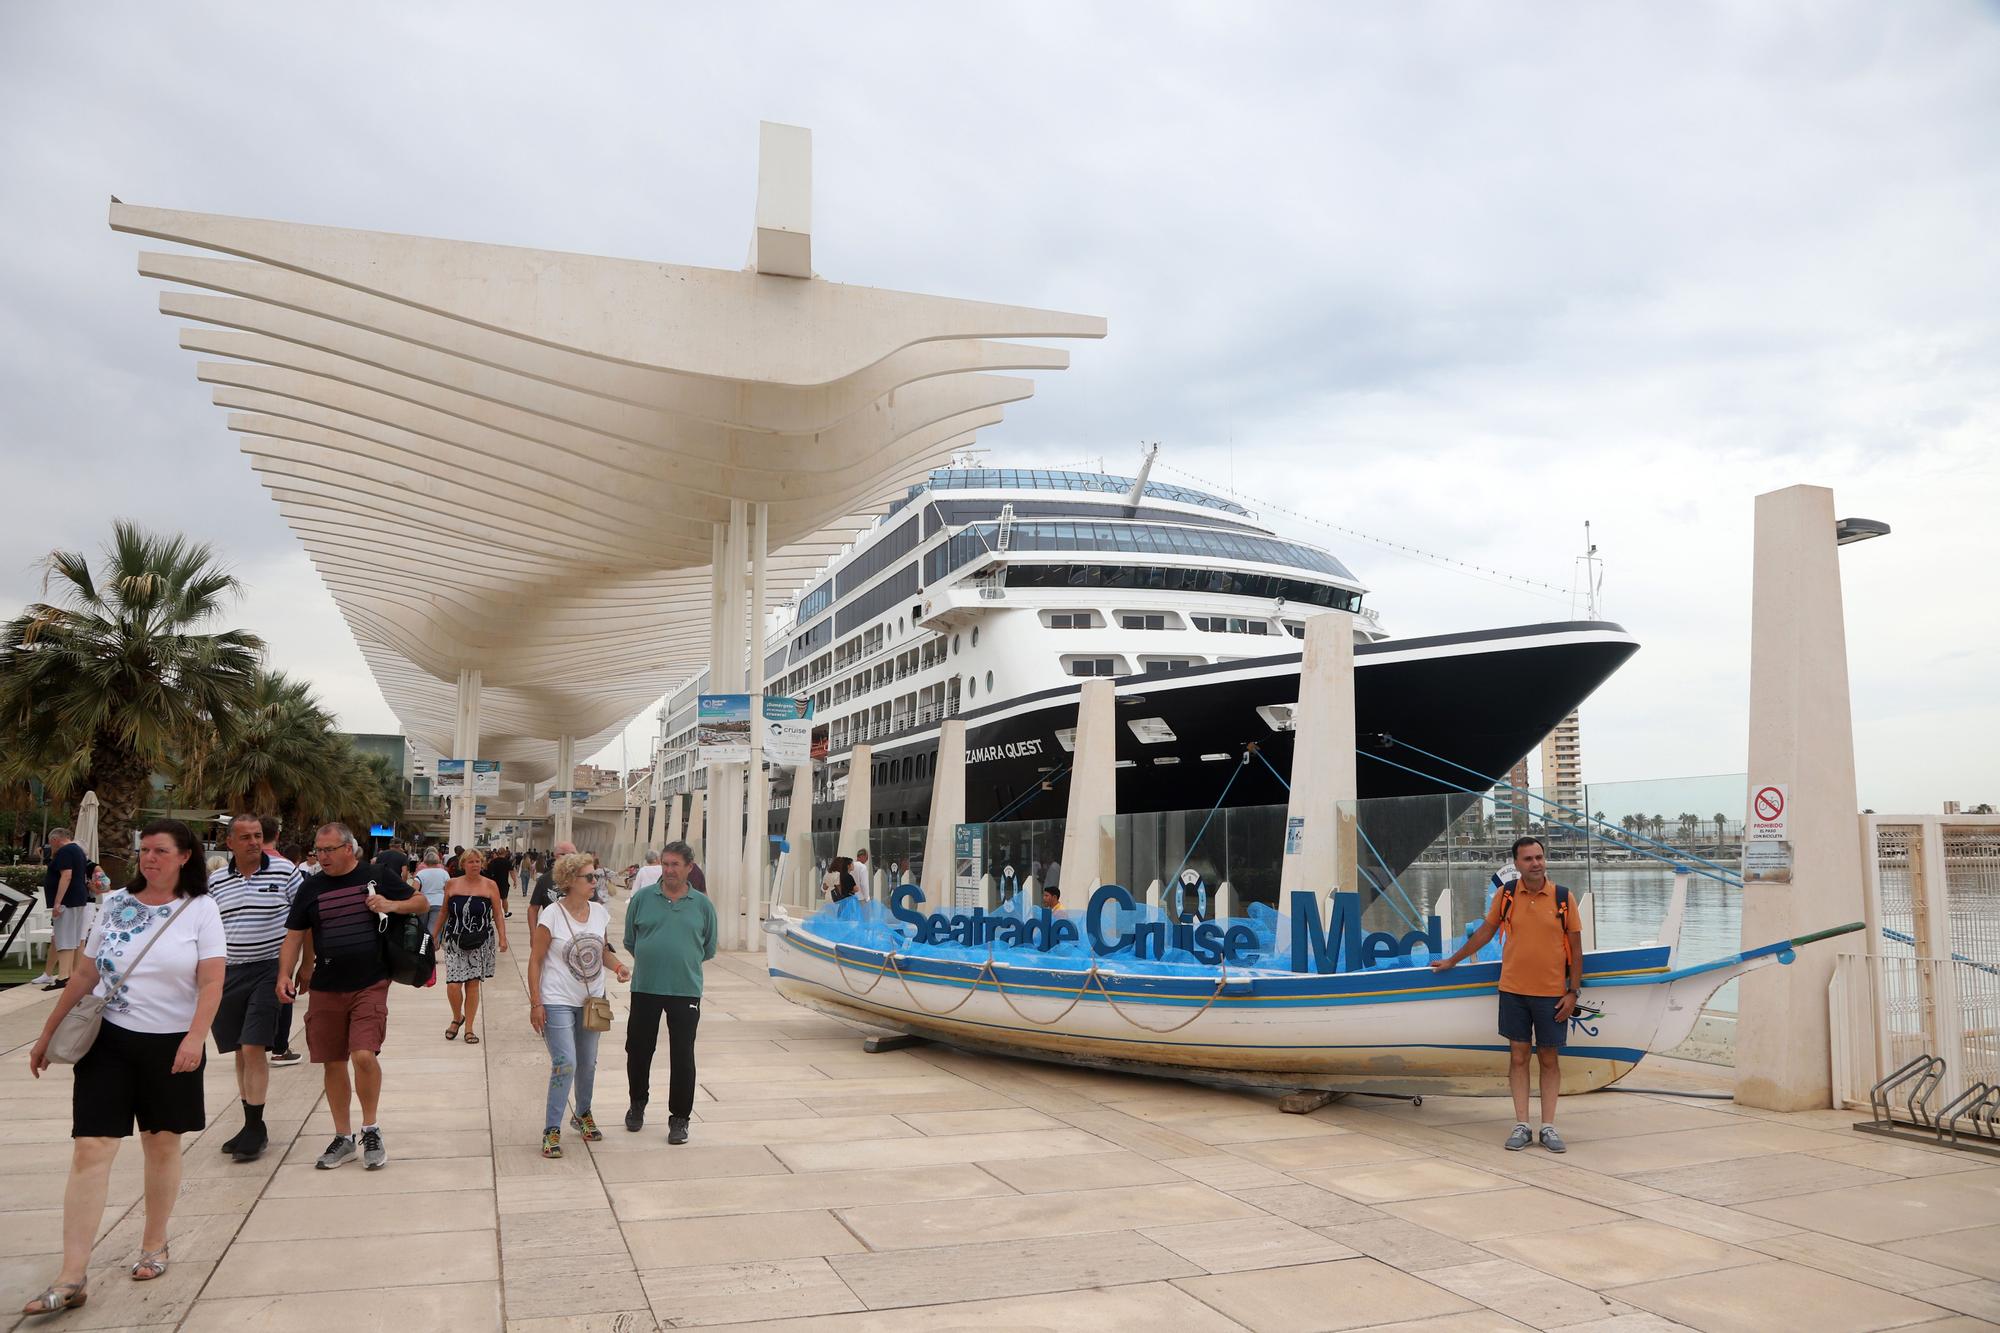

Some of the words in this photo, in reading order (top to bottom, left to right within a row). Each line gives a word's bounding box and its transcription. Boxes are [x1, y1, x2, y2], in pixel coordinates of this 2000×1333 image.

[965, 744, 1006, 764] ZAMARA
[1005, 739, 1043, 759] QUEST
[891, 884, 1079, 952] Seatrade
[1086, 884, 1260, 967] Cruise
[1291, 891, 1443, 974] Med
